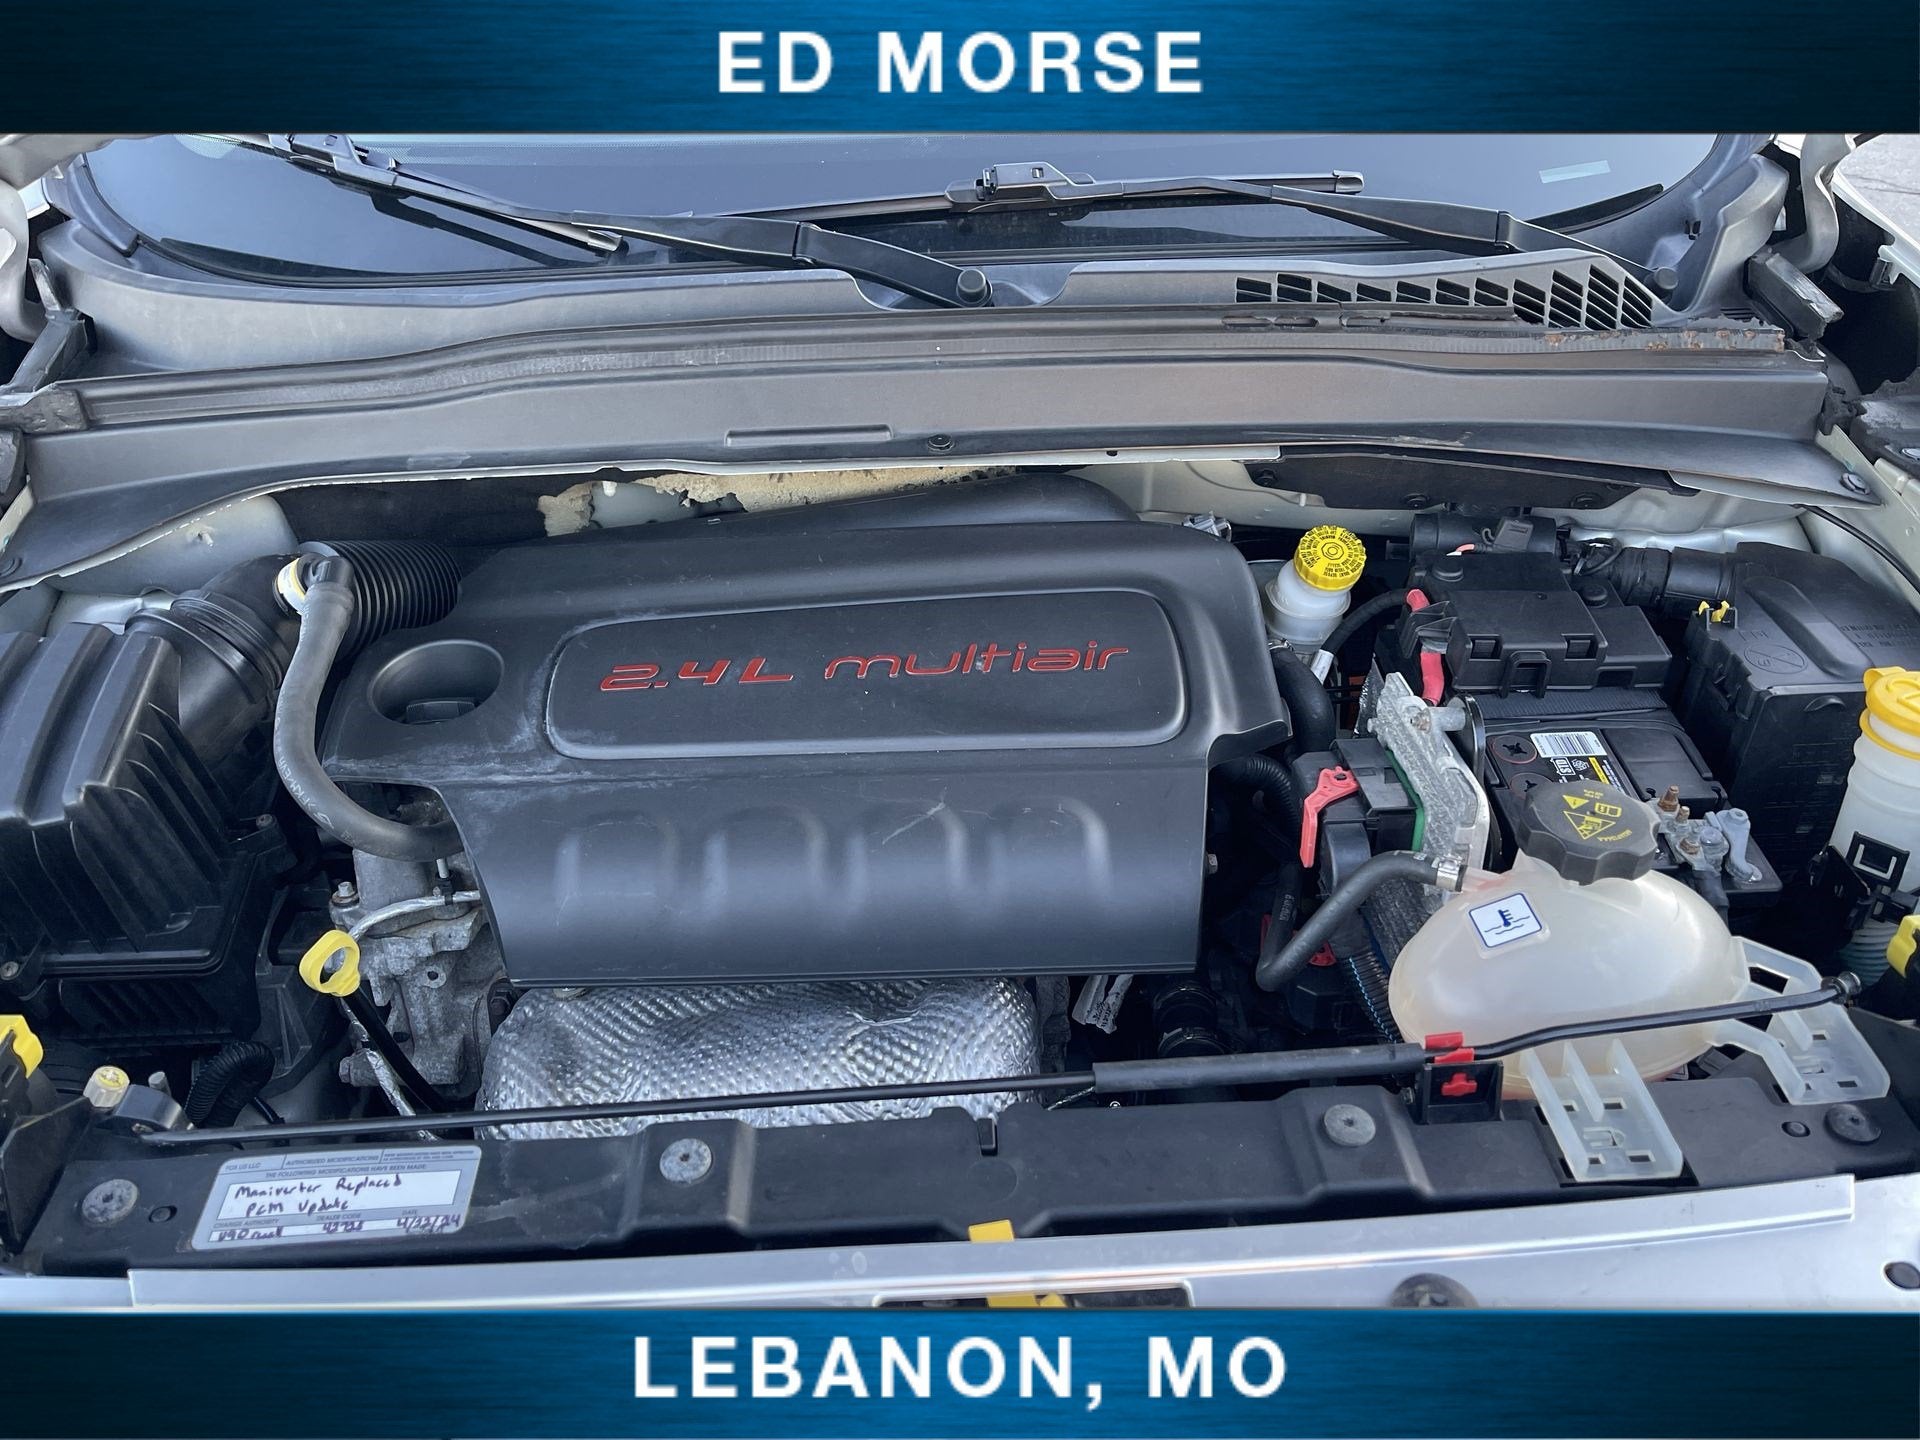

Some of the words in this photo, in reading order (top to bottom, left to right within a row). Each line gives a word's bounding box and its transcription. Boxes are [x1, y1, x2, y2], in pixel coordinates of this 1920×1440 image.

[824, 640, 1129, 680] multiair
[336, 1174, 402, 1196] Replaced
[298, 1197, 349, 1216] Update
